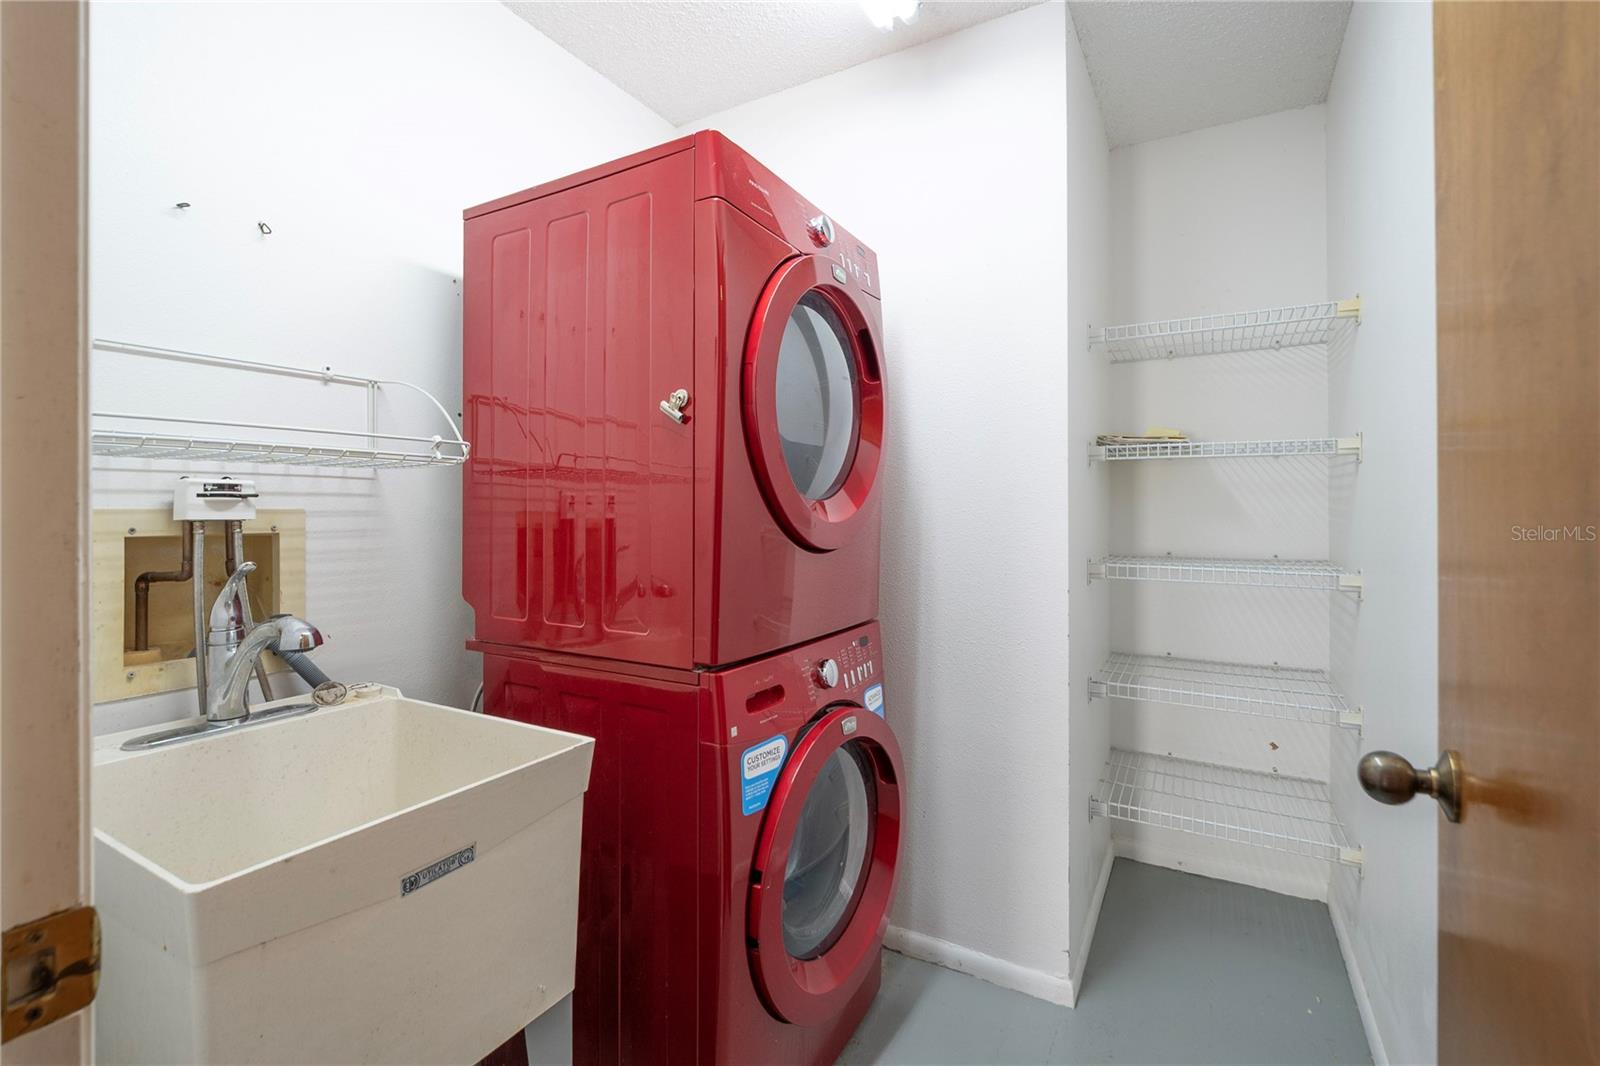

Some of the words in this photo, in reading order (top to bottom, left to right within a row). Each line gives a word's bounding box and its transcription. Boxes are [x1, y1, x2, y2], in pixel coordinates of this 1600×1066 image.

[747, 746, 781, 765] CUSTOMIZE
[747, 761, 761, 772] YOUR
[761, 754, 781, 768] SETTINGS
